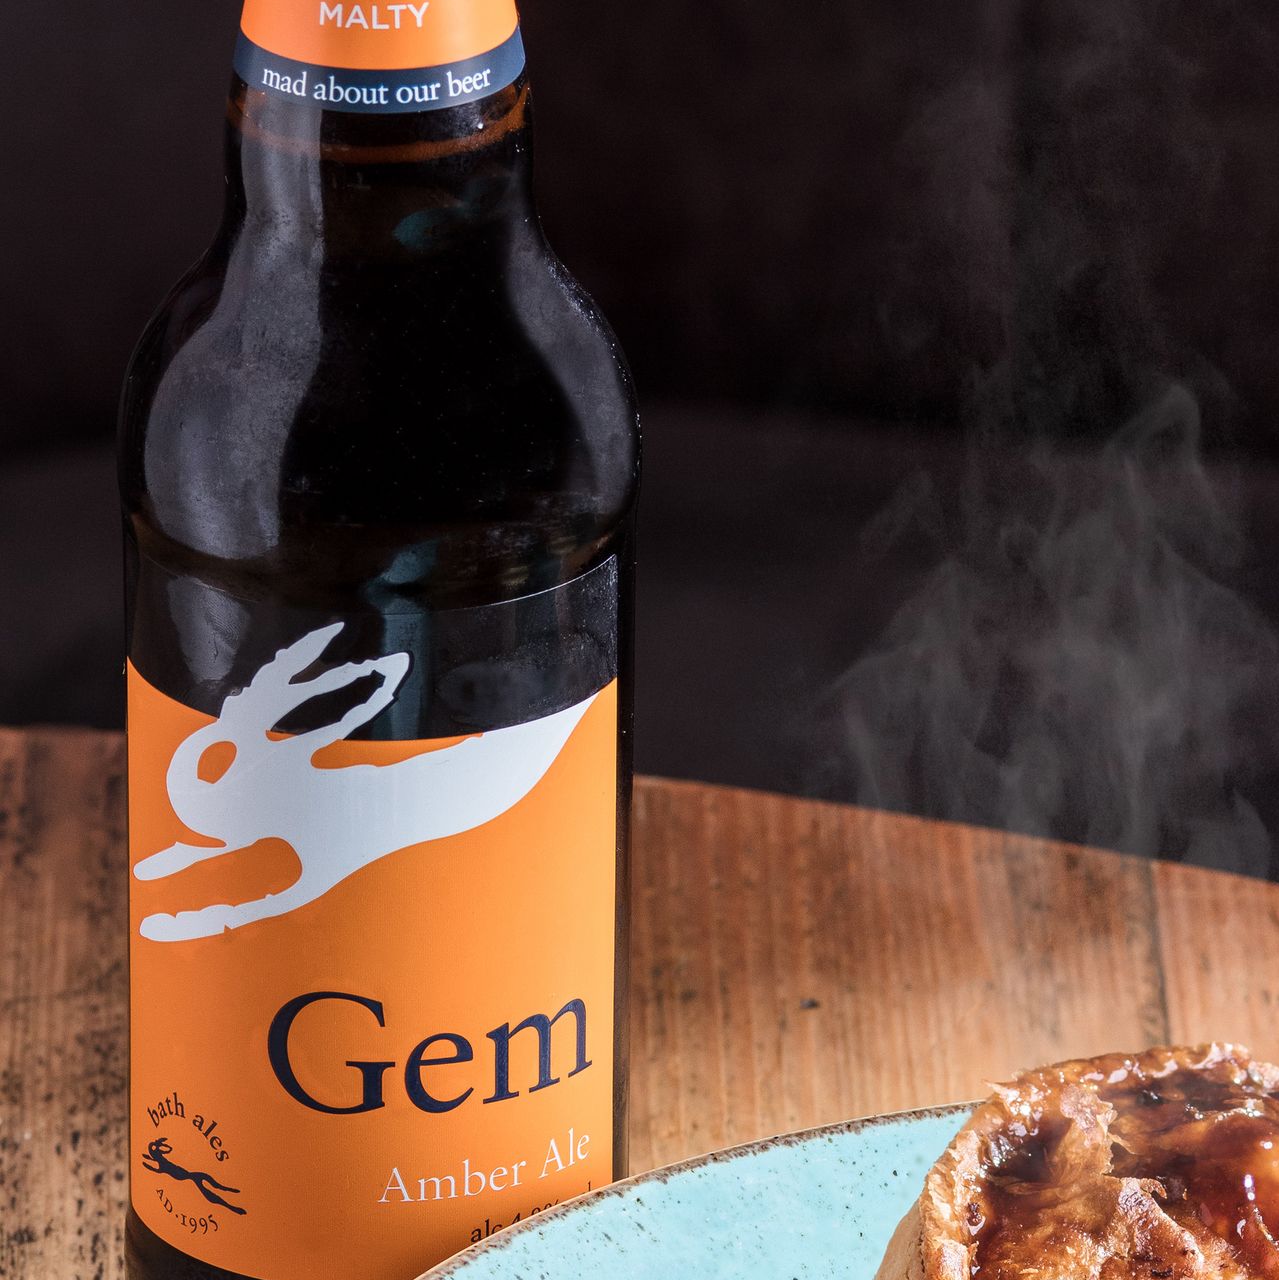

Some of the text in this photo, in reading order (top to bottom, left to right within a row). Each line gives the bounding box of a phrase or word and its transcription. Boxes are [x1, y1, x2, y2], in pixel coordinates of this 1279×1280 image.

[319, 1, 429, 30] MALTY
[262, 68, 491, 104] mad about our beer
[267, 991, 592, 1114] Gem
[147, 1092, 229, 1162] bath ales
[377, 1127, 590, 1203] Amber Ale
